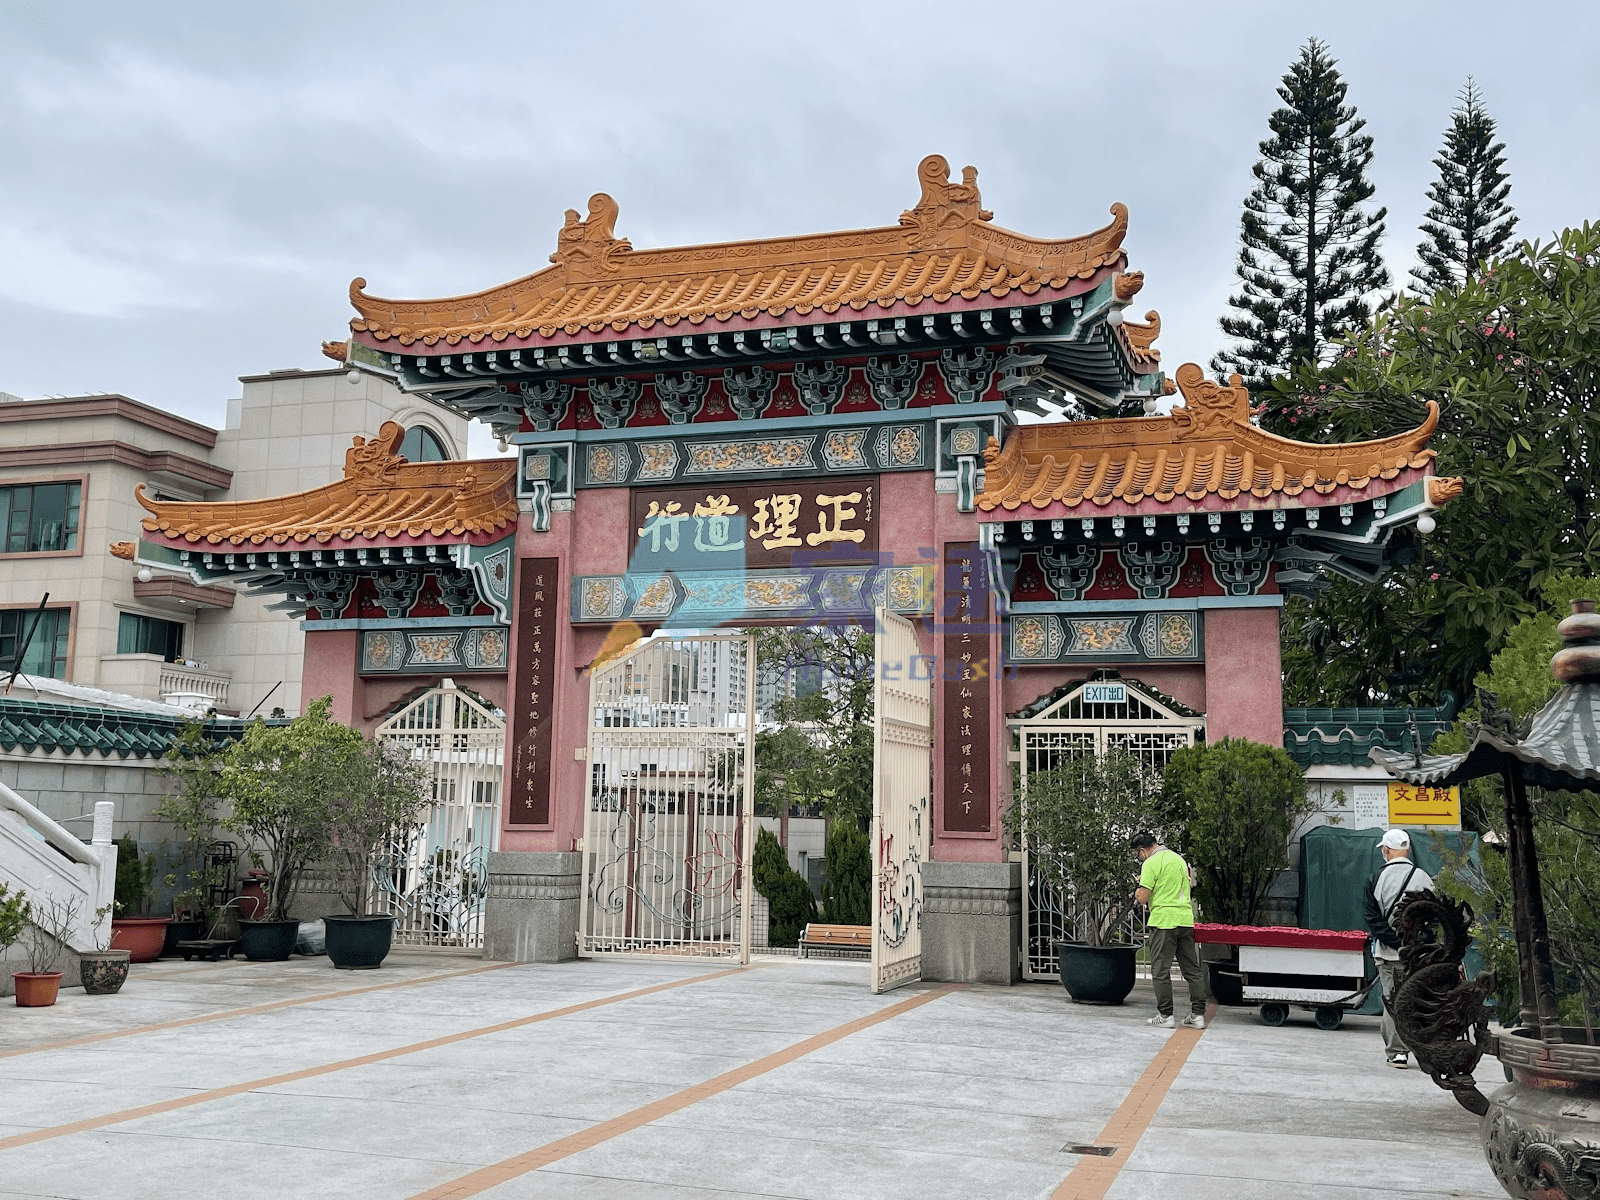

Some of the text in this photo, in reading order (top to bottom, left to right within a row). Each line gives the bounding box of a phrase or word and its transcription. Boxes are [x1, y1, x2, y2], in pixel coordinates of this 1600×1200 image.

[1085, 686, 1124, 701] EXIT 出口
[1394, 787, 1452, 802] 文昌殿
